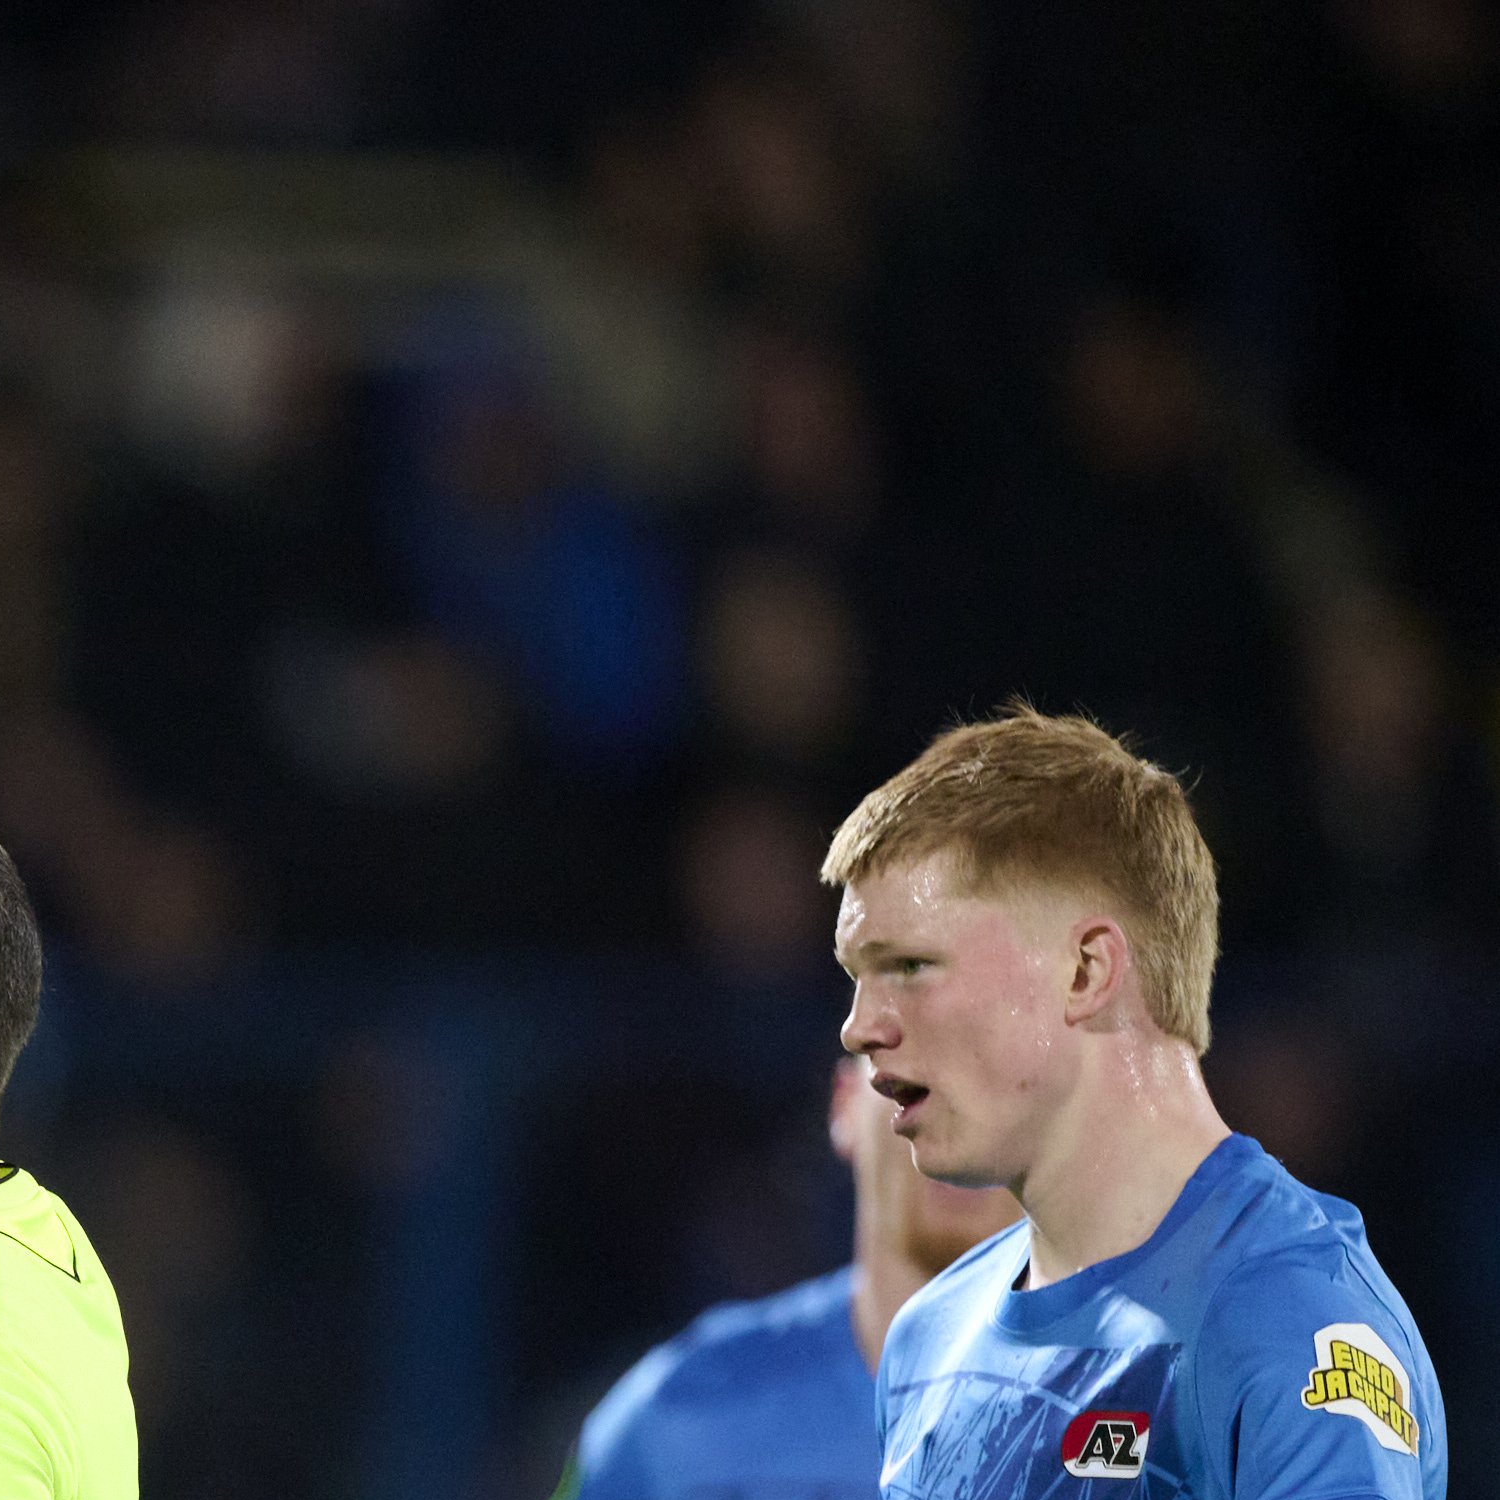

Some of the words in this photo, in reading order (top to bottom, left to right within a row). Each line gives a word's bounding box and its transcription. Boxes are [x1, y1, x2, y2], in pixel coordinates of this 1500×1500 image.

[1330, 1340, 1396, 1400] EURO
[1305, 1368, 1413, 1448] JACKPOT
[1076, 1420, 1141, 1470] AZ
